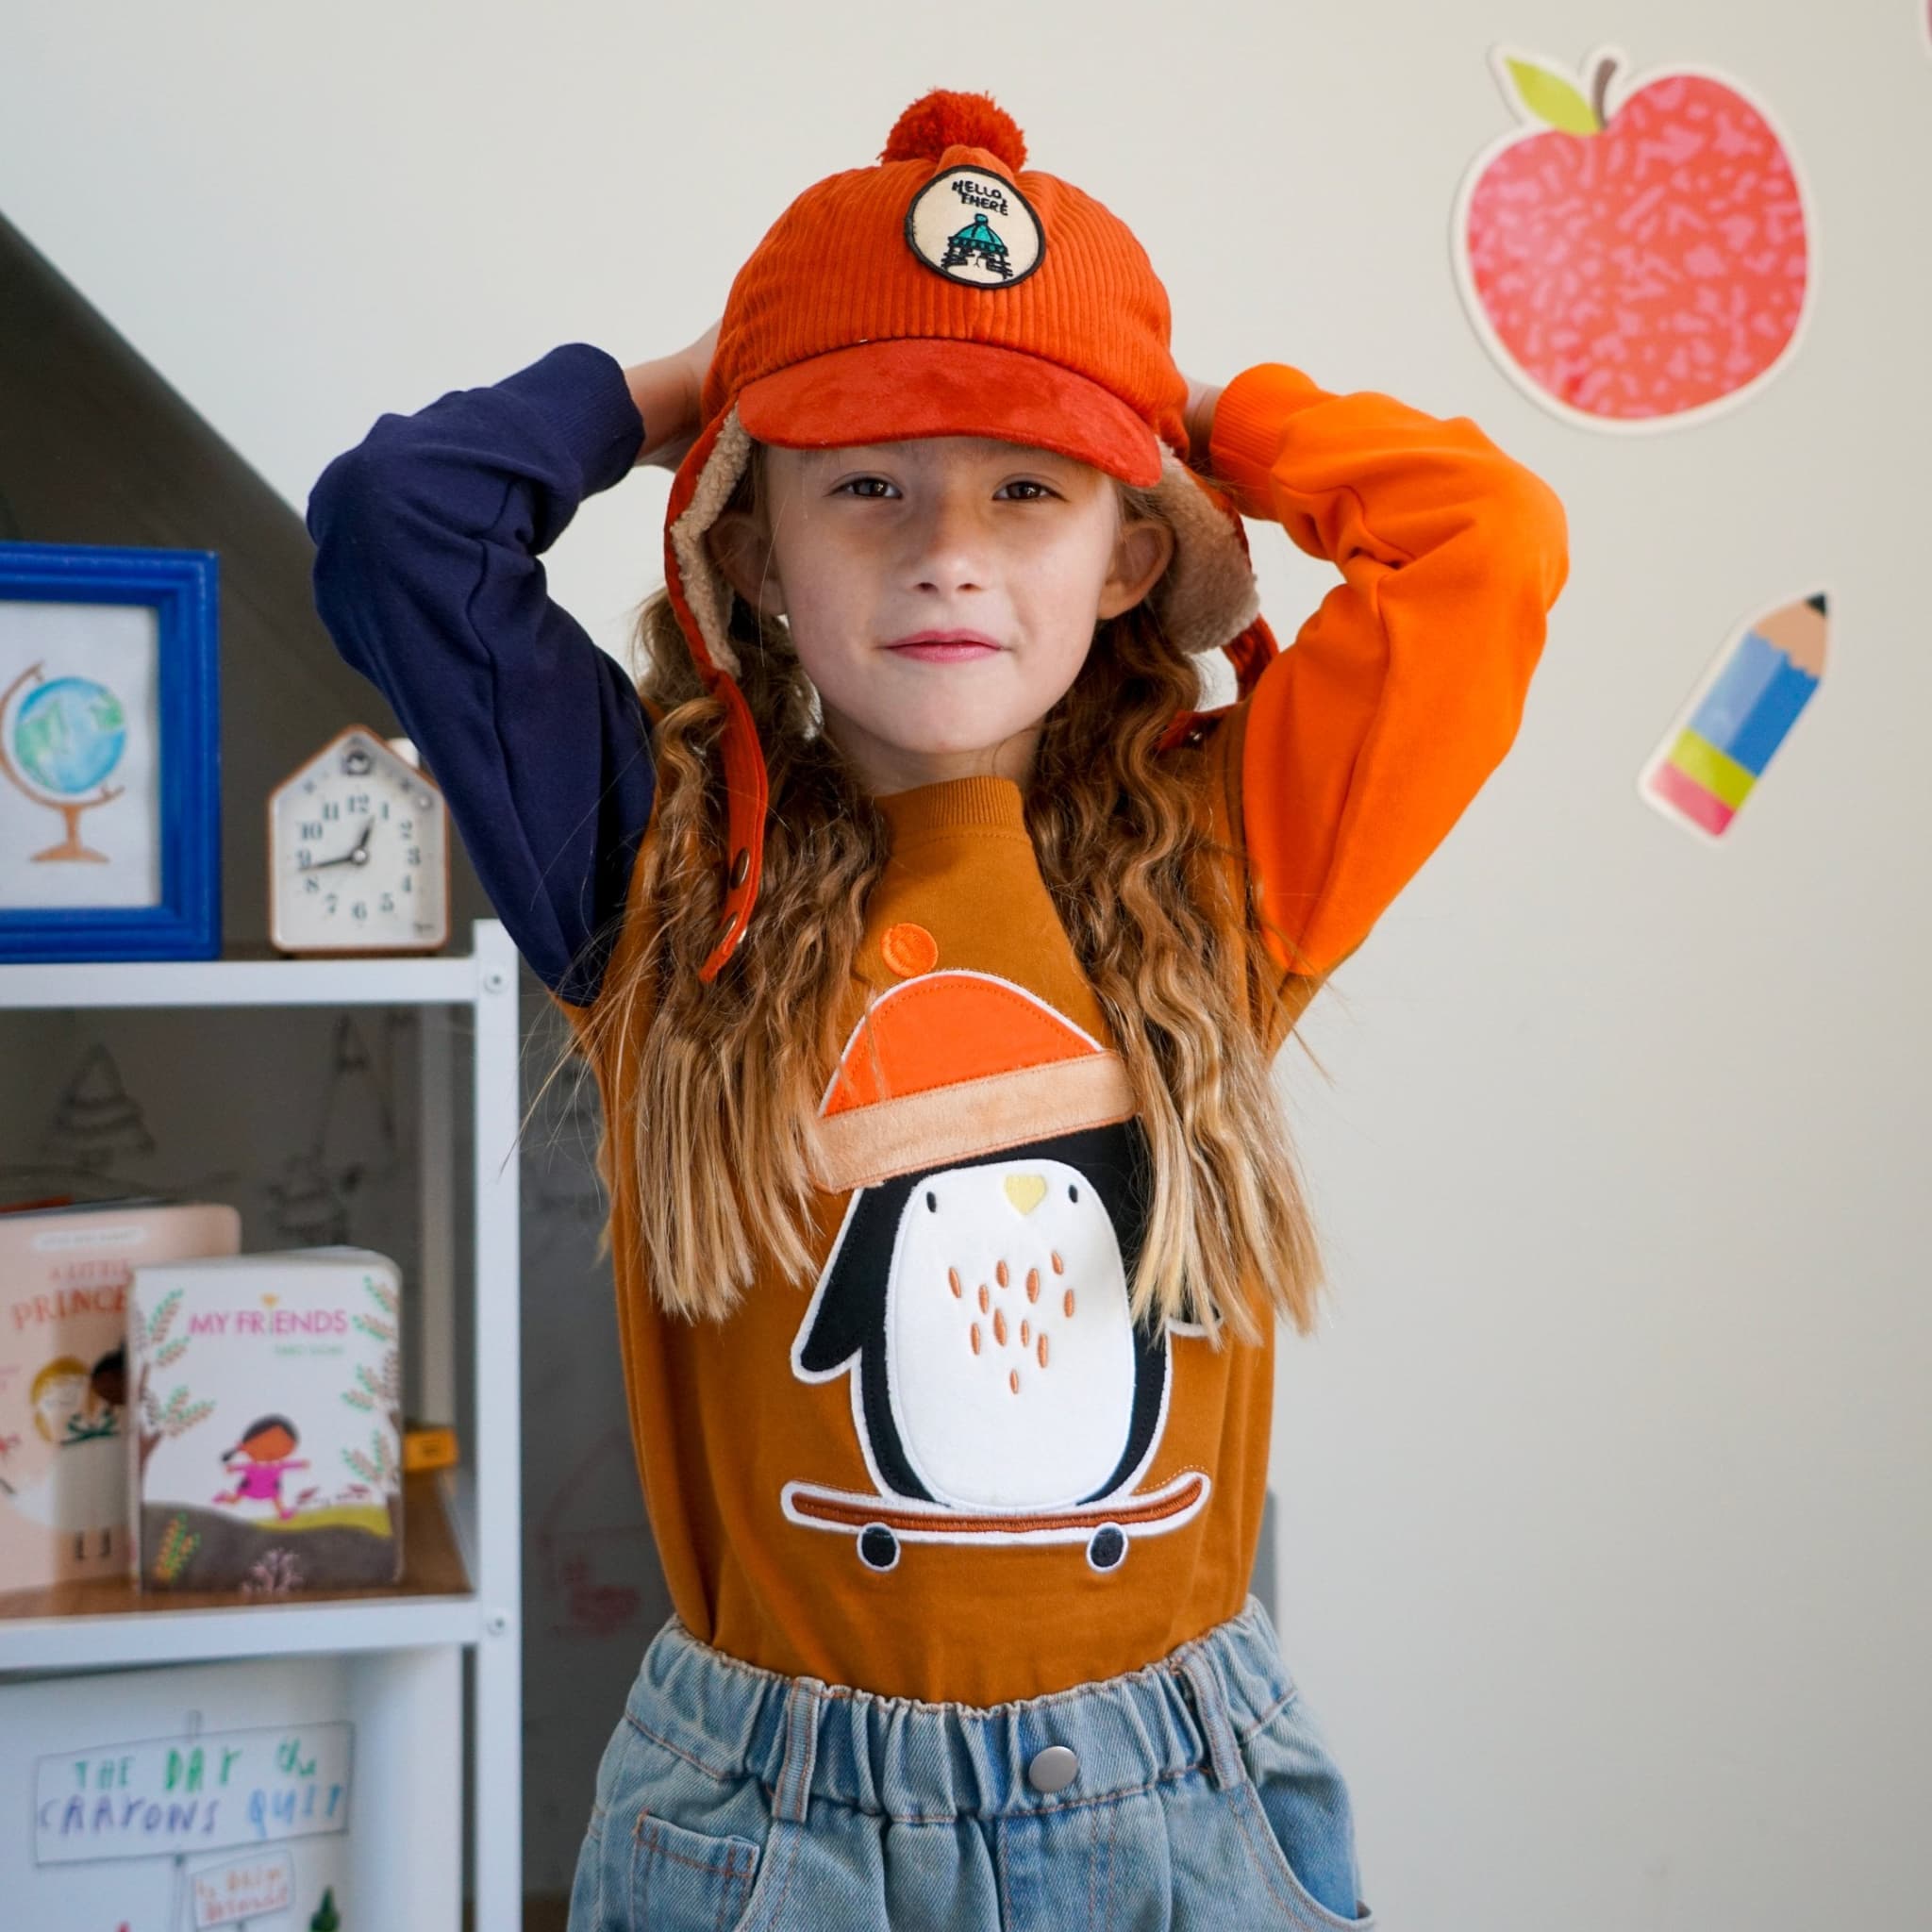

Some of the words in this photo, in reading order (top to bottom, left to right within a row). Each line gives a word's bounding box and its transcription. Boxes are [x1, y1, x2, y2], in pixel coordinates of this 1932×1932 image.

[958, 192, 1008, 216] THERE
[323, 803, 340, 821] 11
[348, 794, 369, 813] 12
[380, 803, 389, 820] 1
[301, 823, 323, 840] 10
[401, 821, 412, 839] 2
[408, 848, 421, 865] 3
[306, 876, 319, 892] 8
[402, 875, 412, 892] 4
[326, 894, 338, 913] 7
[381, 893, 393, 911] 5
[353, 903, 367, 920] 6
[191, 1312, 228, 1335] MY
[236, 1309, 348, 1336] FRIENDS
[74, 1756, 135, 1790] THE
[164, 1746, 242, 1791] DAY
